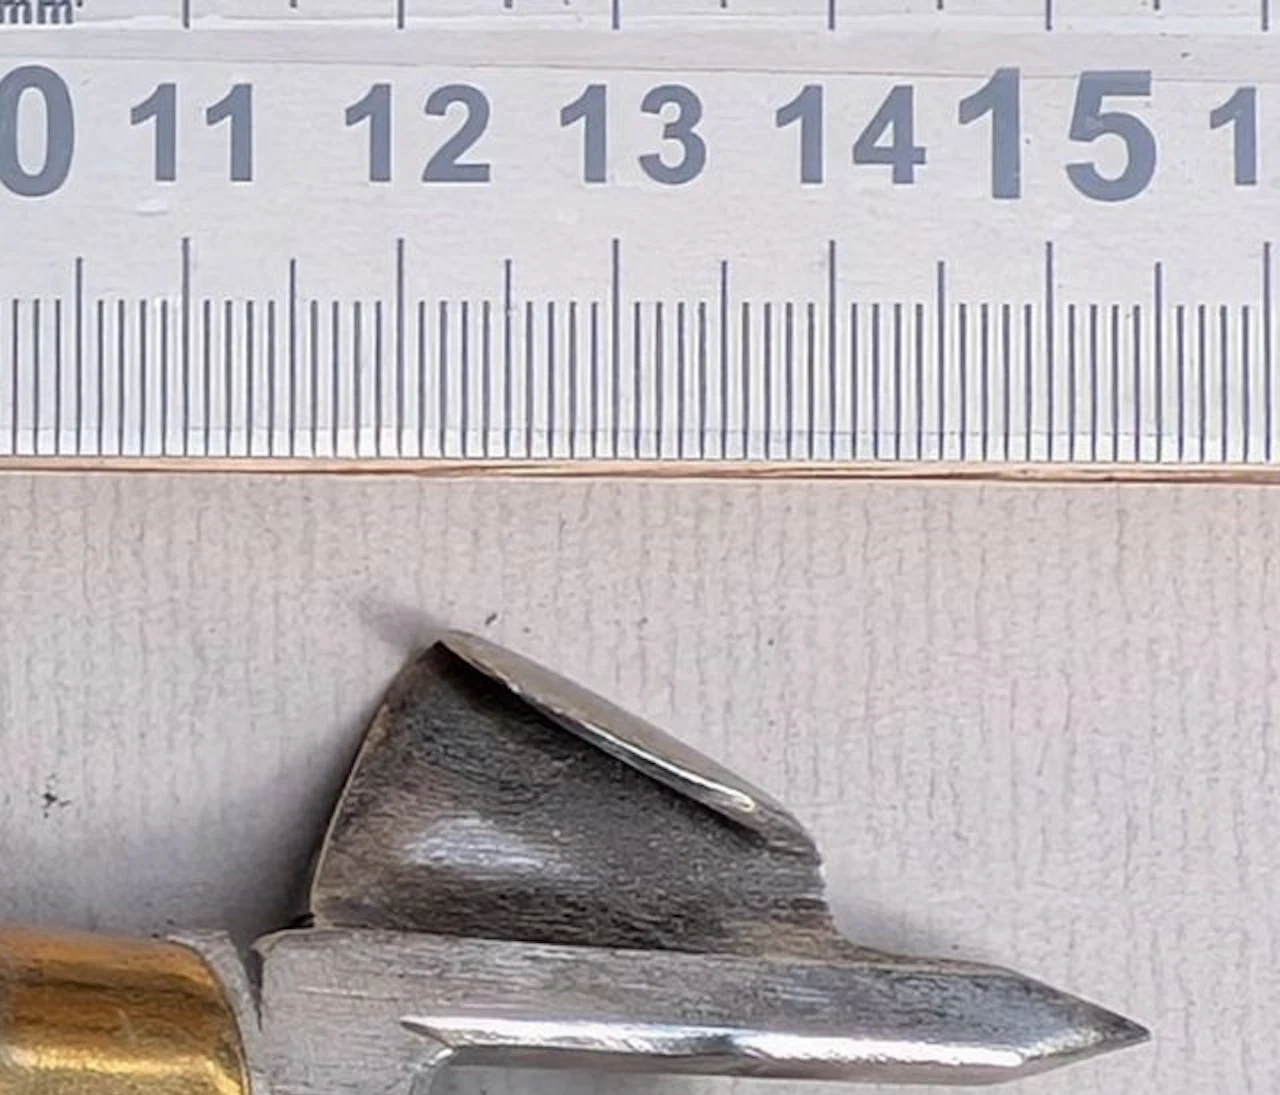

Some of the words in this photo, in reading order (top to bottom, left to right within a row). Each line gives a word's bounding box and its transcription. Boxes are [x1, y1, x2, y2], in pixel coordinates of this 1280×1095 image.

[131, 83, 253, 182] 11
[345, 83, 491, 183] 12
[560, 84, 707, 185] 13
[776, 85, 927, 185] 14
[958, 67, 1157, 202] 15
